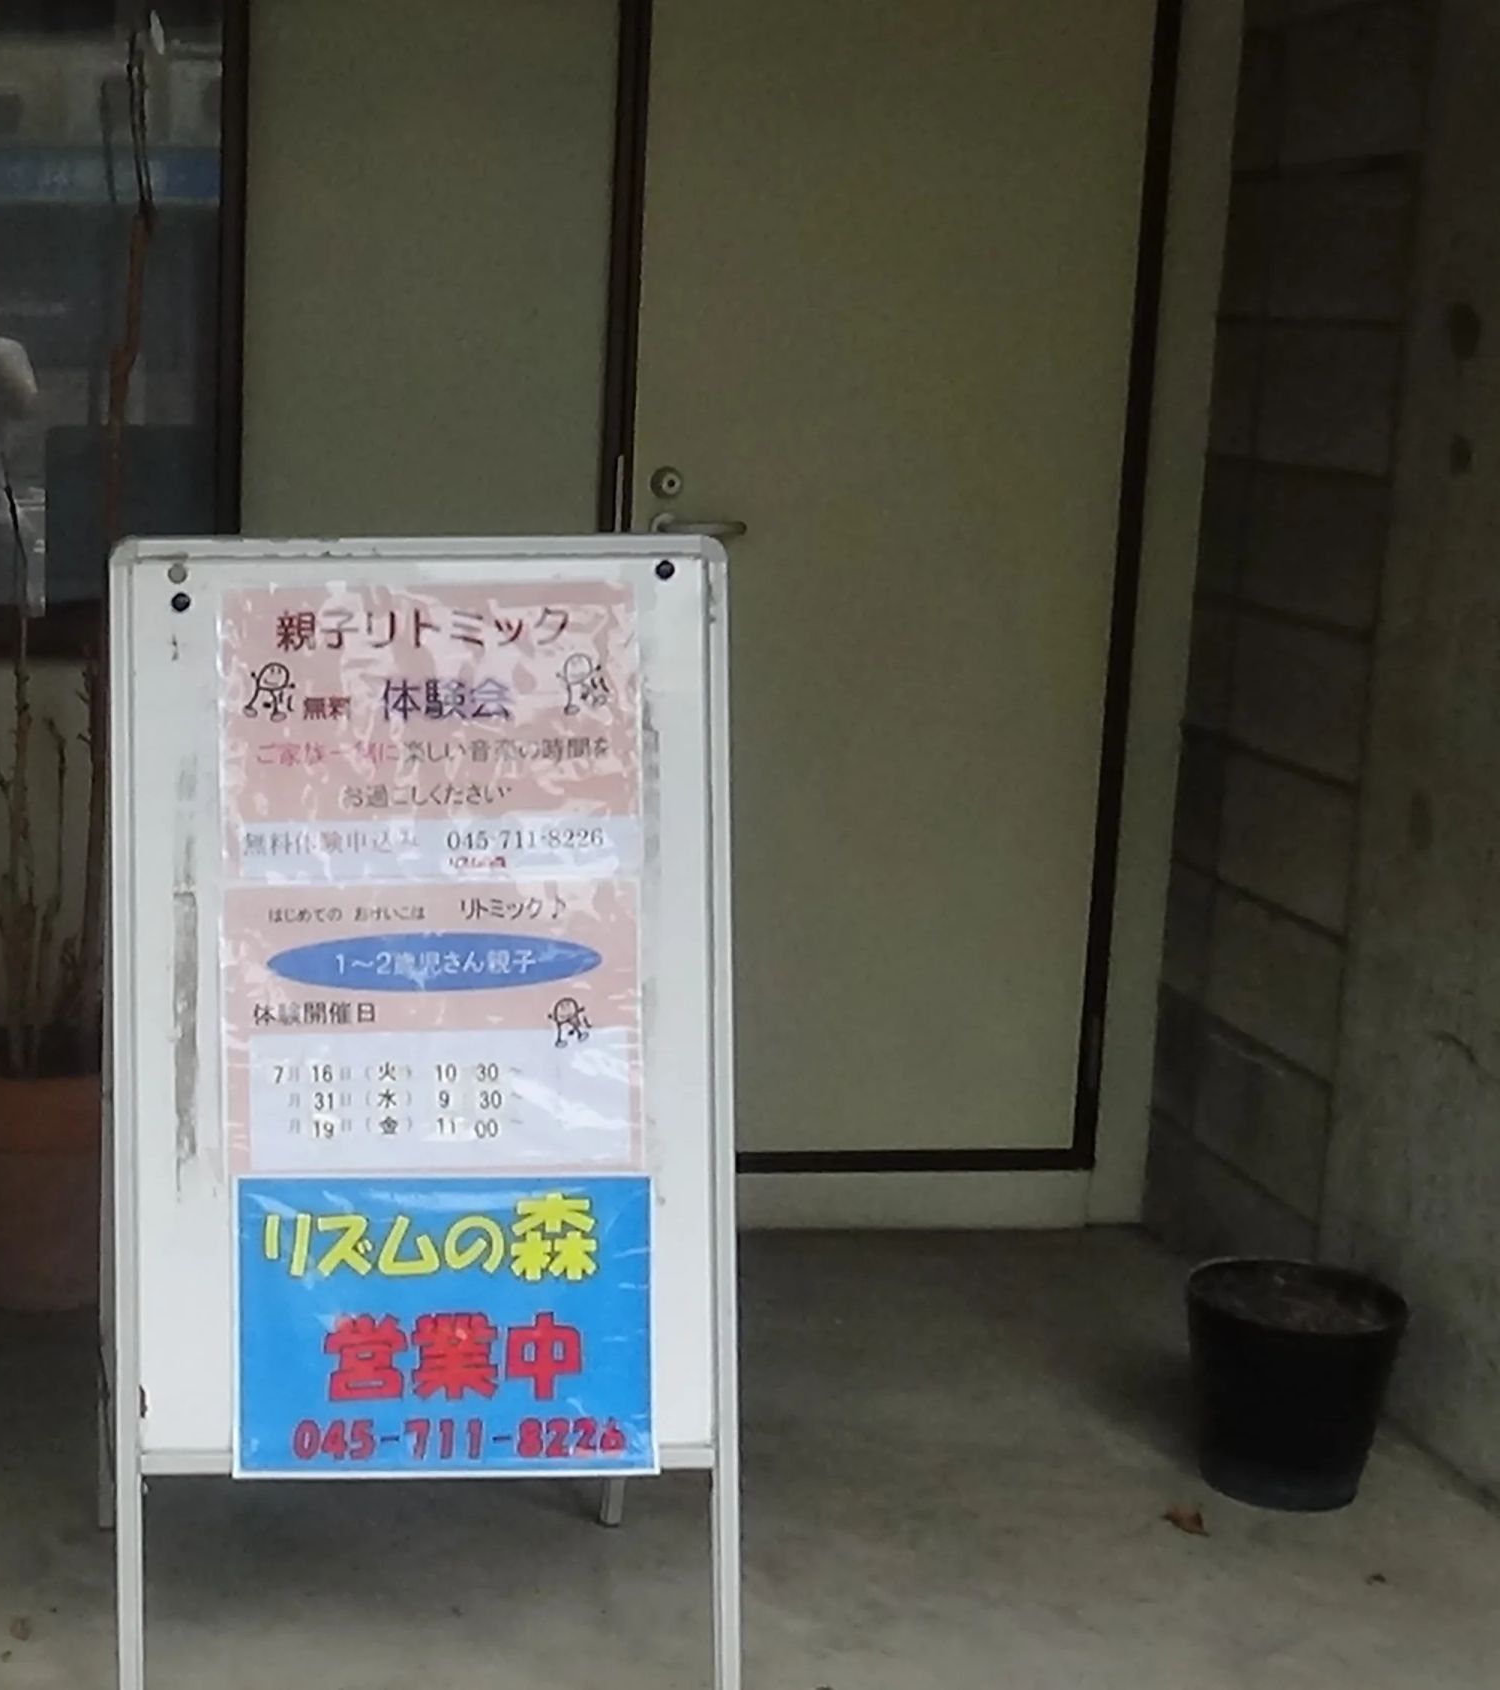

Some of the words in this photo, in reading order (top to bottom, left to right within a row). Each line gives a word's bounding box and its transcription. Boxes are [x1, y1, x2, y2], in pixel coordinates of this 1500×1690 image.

[276, 607, 569, 651] 親子リトミック
[303, 697, 350, 719] 無料
[382, 678, 513, 721] 体験会
[269, 906, 342, 922] はじめての
[354, 905, 425, 921] おけいこは
[254, 1002, 376, 1026] 体験開催日
[264, 1191, 598, 1281] リズムの森
[324, 1309, 583, 1402] 営業中
[294, 1417, 626, 1461] 045-711-8226
